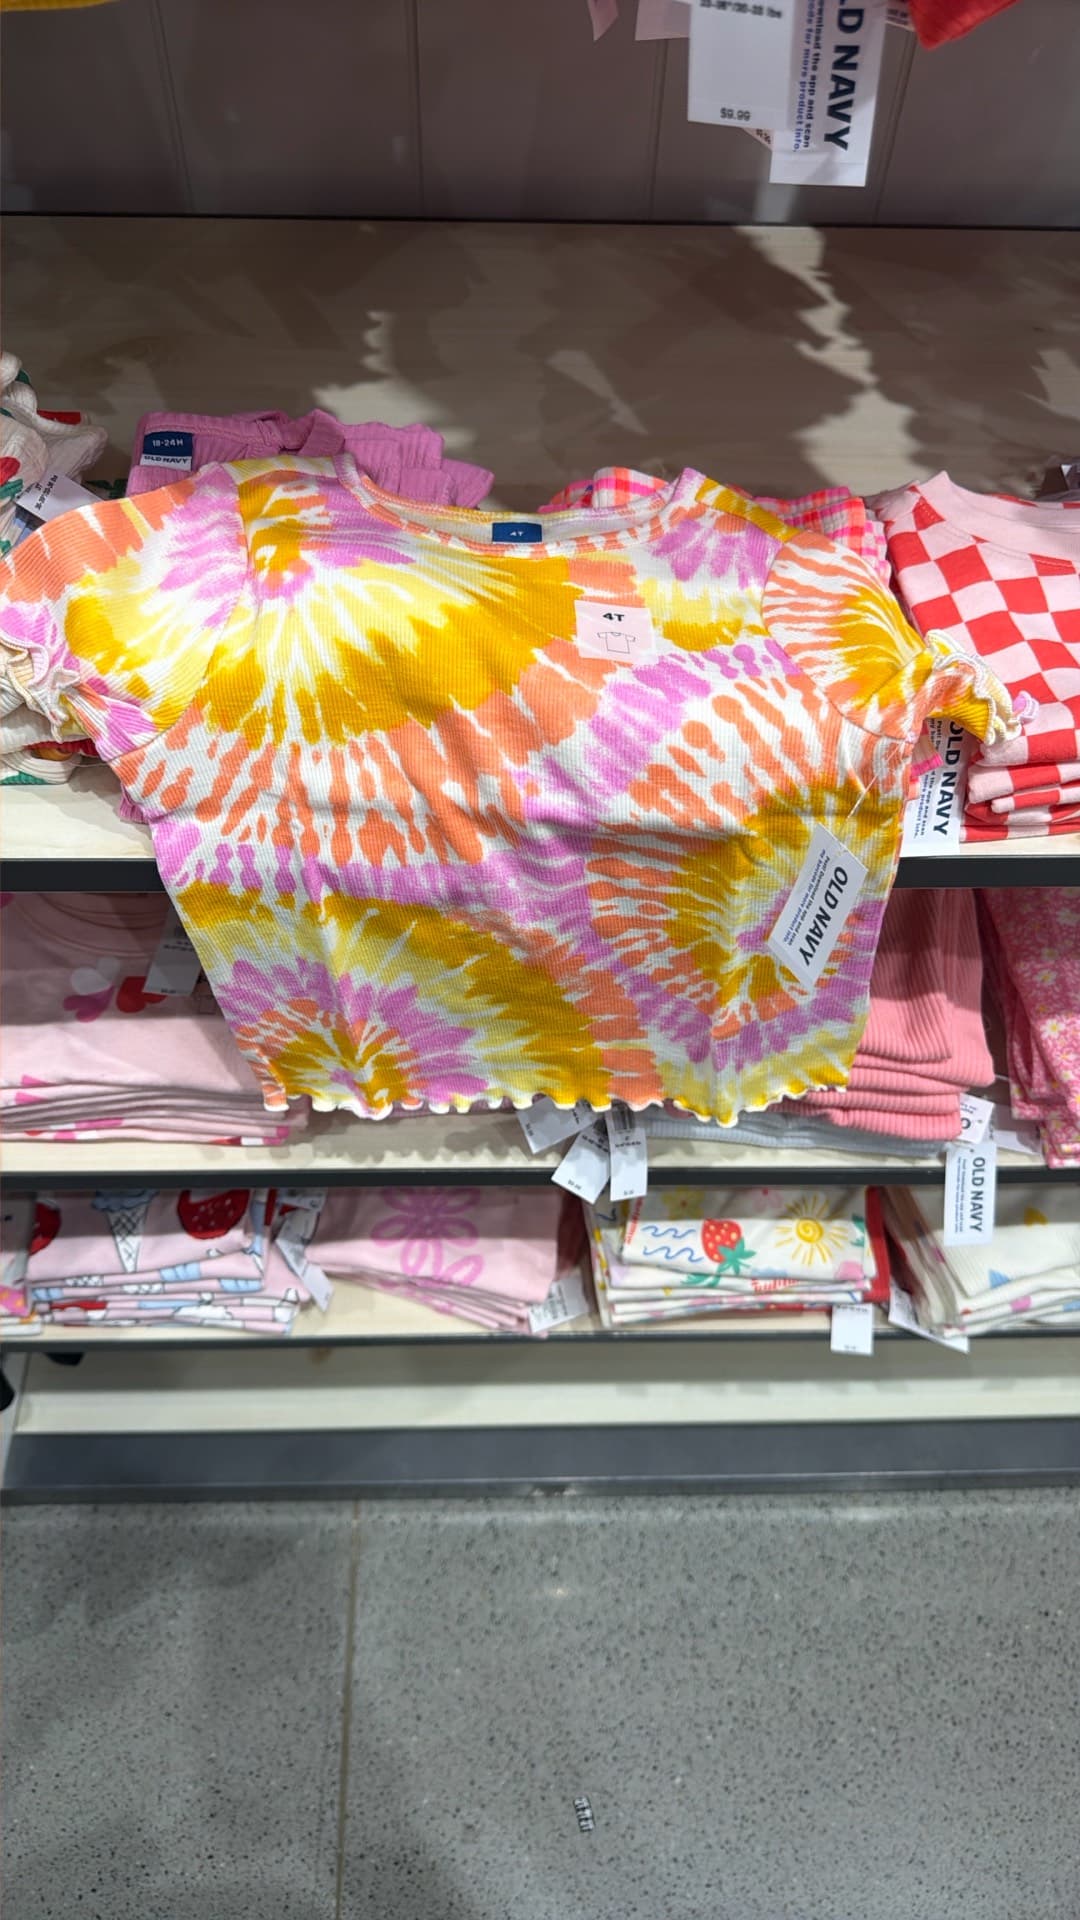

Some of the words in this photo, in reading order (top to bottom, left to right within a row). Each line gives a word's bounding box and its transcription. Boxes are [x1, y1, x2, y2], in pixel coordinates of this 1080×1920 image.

[813, 0, 824, 49] ownload
[811, 53, 821, 72] the
[808, 75, 817, 96] app
[824, 45, 860, 151] NAVY
[720, 107, 751, 121] $9.99
[796, 81, 807, 125] product
[806, 99, 814, 120] and
[792, 128, 804, 153] info.
[803, 123, 812, 148] scan
[152, 439, 184, 447] 18-24M
[162, 457, 188, 465] NAVY
[602, 612, 625, 622] 4T
[933, 772, 958, 836] NAVY
[824, 866, 848, 910] OLD
[794, 920, 802, 932] and
[798, 908, 807, 921] app
[799, 906, 832, 966] NAVY
[971, 1157, 986, 1187] OLD
[970, 1190, 985, 1233] NAVY
